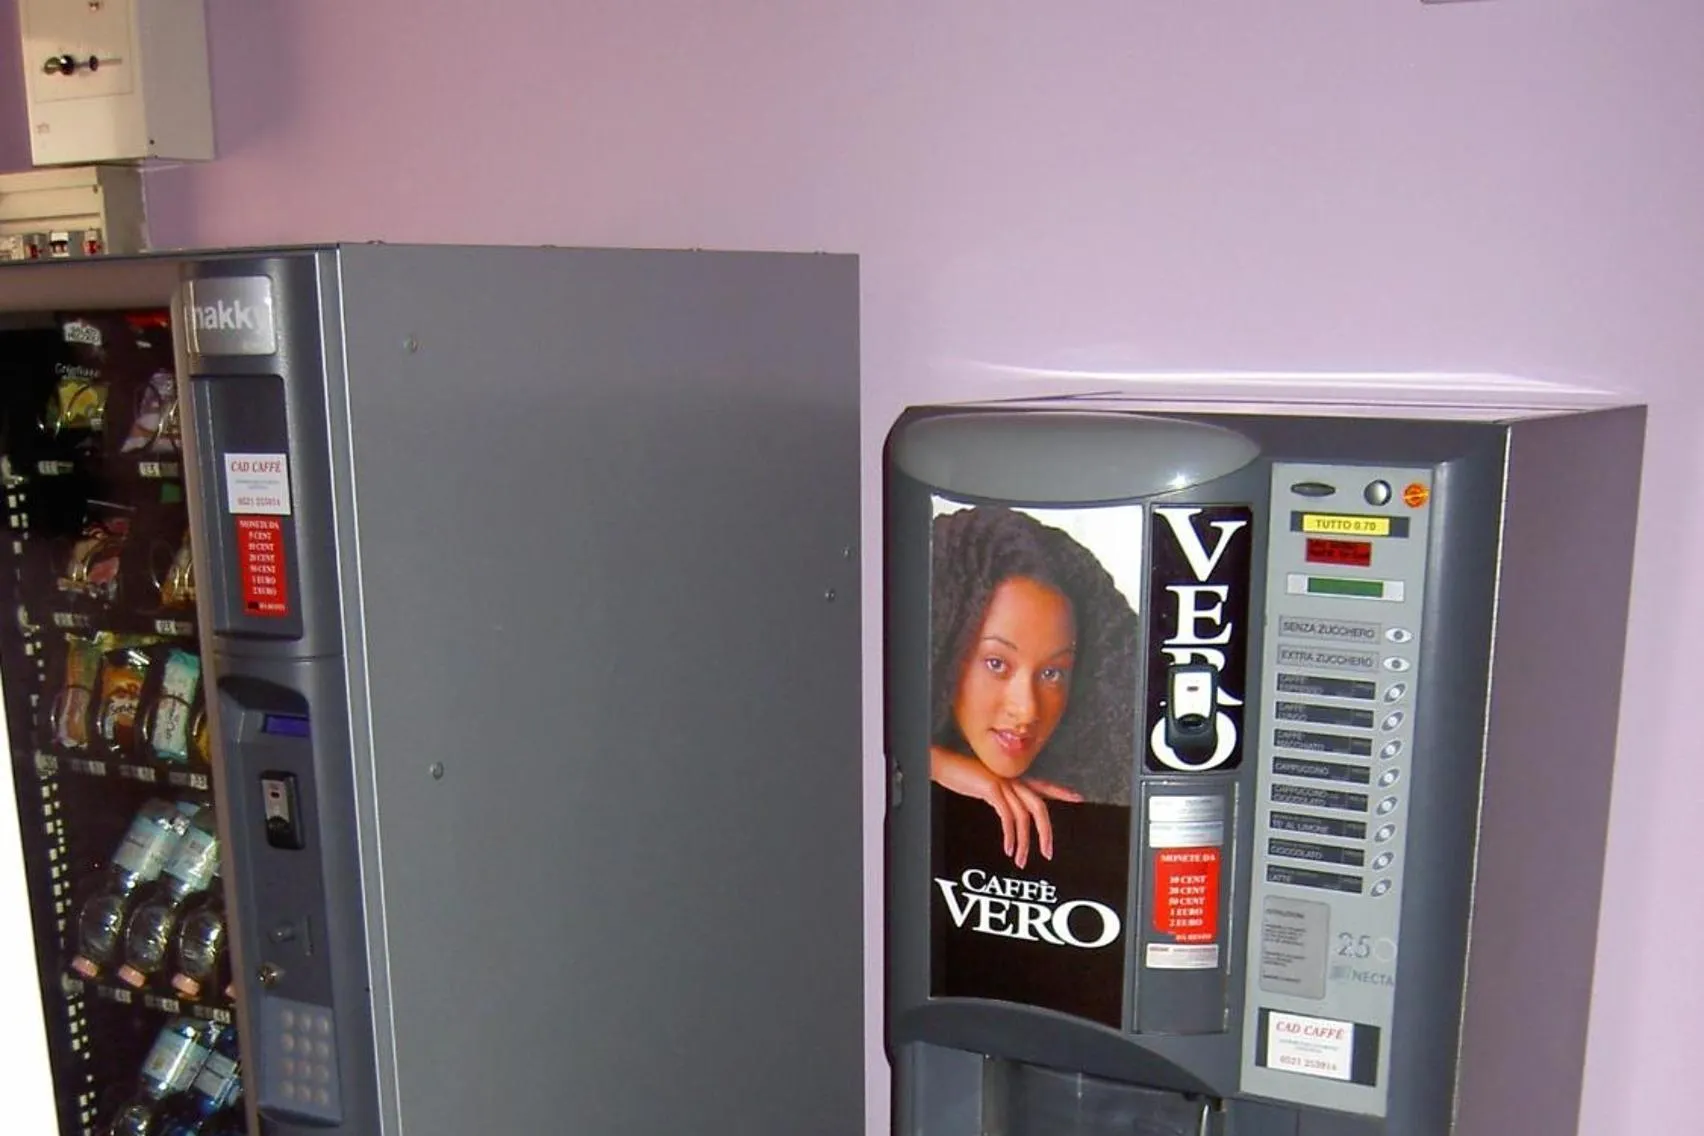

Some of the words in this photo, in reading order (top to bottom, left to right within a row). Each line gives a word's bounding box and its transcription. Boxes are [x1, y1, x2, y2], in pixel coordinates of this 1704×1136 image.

[231, 460, 249, 473] CAD
[1316, 519, 1352, 530] TUTTO
[254, 531, 272, 540] CENT
[256, 543, 274, 551] CENT
[257, 554, 275, 562] CENT
[257, 565, 275, 573] CENT
[1283, 621, 1315, 633] SENZA
[1318, 624, 1375, 638] ZUCCHERO
[1281, 650, 1313, 661] EXTRA
[1316, 654, 1373, 667] ZUCCHERO
[1161, 854, 1201, 862] MONETE
[1180, 875, 1206, 883] CENT
[1179, 897, 1206, 905] CENT
[934, 876, 1121, 948] VERO
[1352, 969, 1394, 986] NECTA
[1276, 1020, 1301, 1034] CAD
